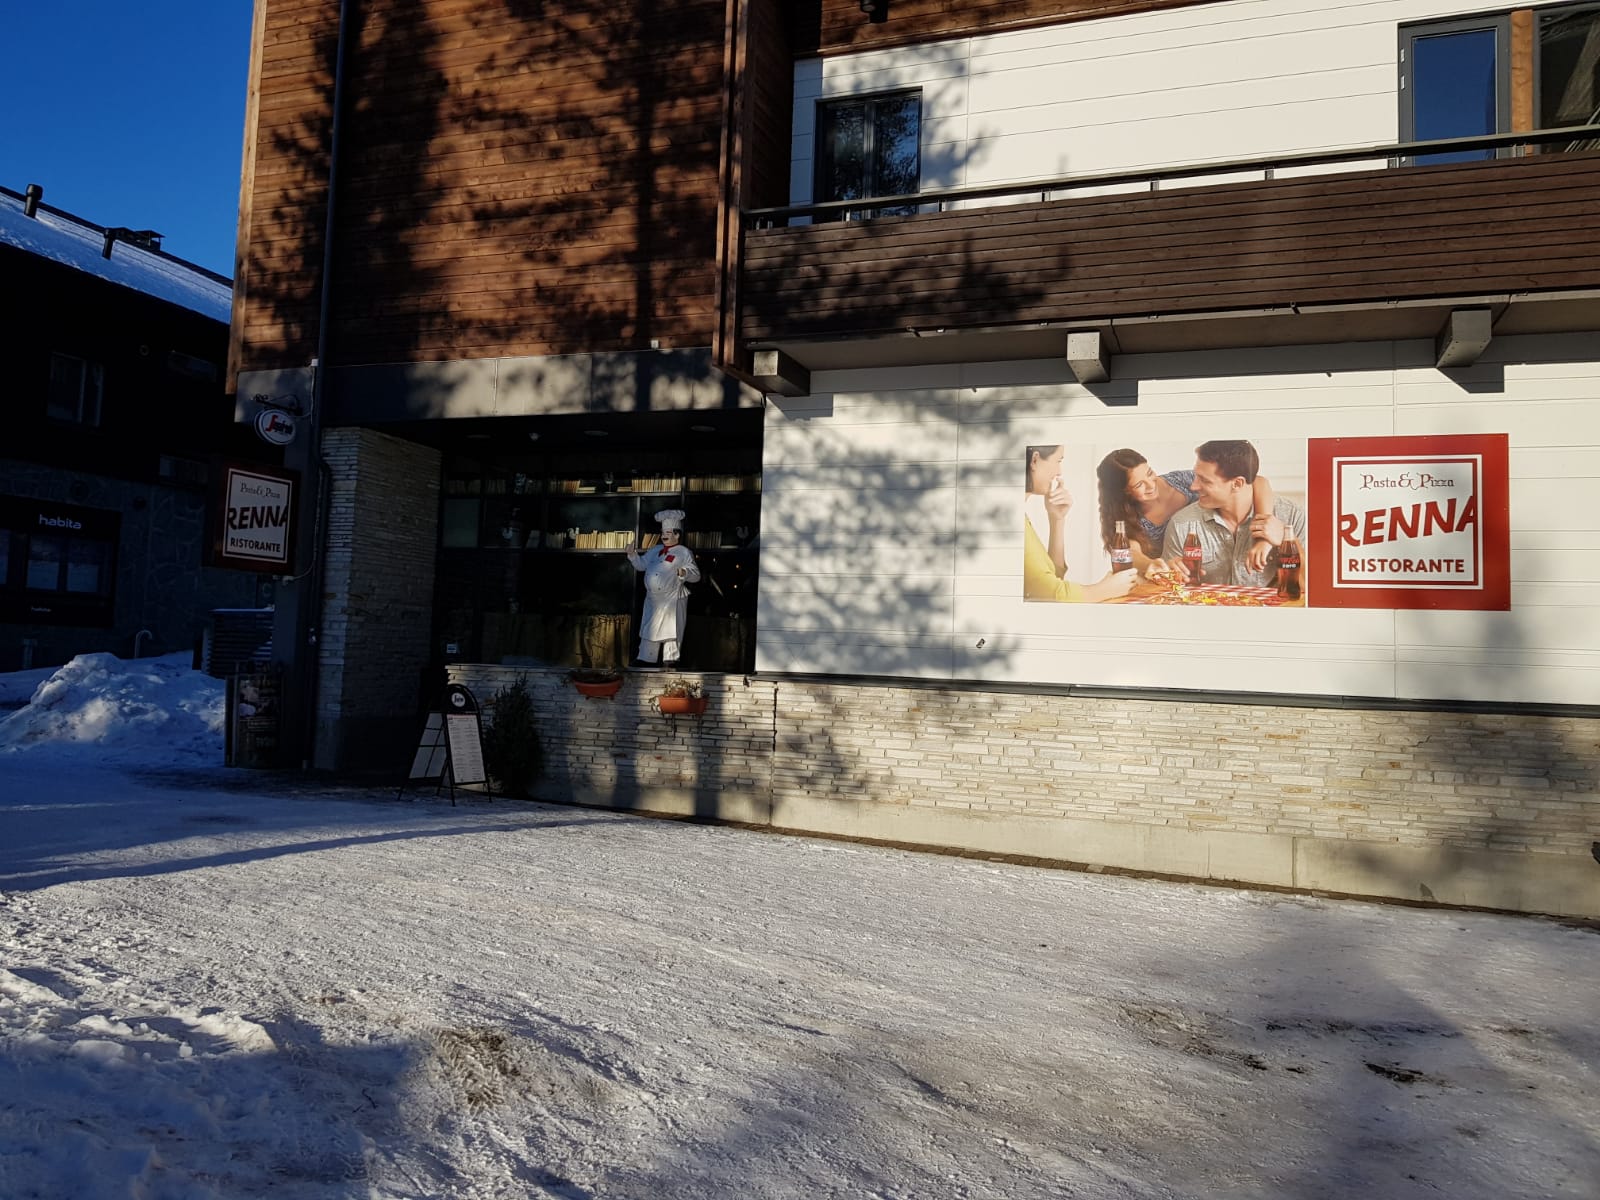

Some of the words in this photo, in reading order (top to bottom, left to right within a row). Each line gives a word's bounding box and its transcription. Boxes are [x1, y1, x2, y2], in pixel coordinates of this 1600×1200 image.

[1359, 473, 1396, 490] Pasta
[1398, 472, 1418, 490] &
[1417, 473, 1455, 489] Pizza
[38, 513, 82, 529] habita
[227, 505, 287, 530] RENNA
[1338, 495, 1475, 547] RENNA
[230, 537, 281, 552] RISTORANTE
[1348, 558, 1465, 573] RISTORANTE
